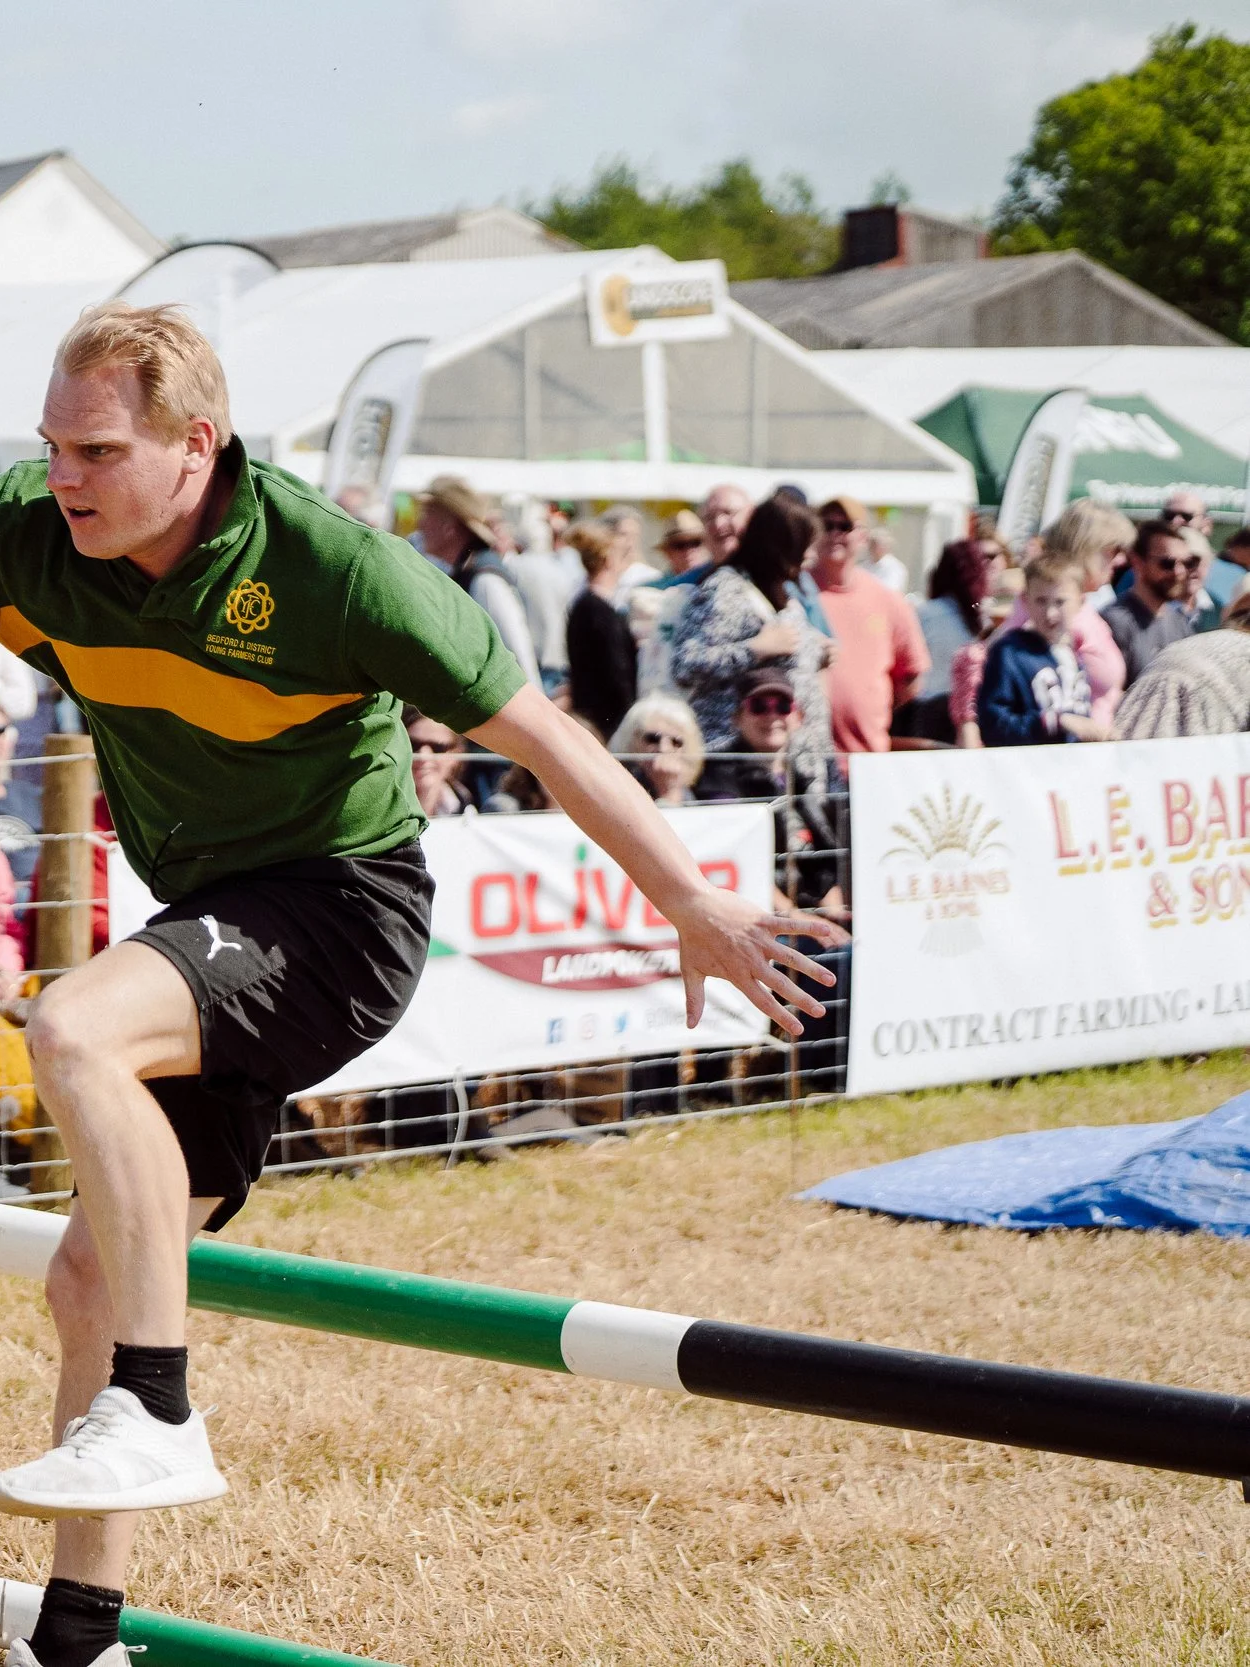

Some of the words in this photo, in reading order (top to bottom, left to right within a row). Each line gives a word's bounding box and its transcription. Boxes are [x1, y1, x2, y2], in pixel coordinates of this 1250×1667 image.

[206, 634, 239, 647] BEDFORD
[239, 640, 245, 649] &
[246, 642, 276, 655] DISTRICT
[206, 644, 226, 655] YOUNG
[227, 648, 256, 662] FARMERS
[256, 655, 274, 665] CLUB
[1048, 784, 1154, 877] L.E.
[1146, 871, 1180, 929] &
[872, 1006, 1049, 1057] CONTRACT
[1053, 988, 1192, 1037] FARMING
[1213, 979, 1250, 1016] LA
